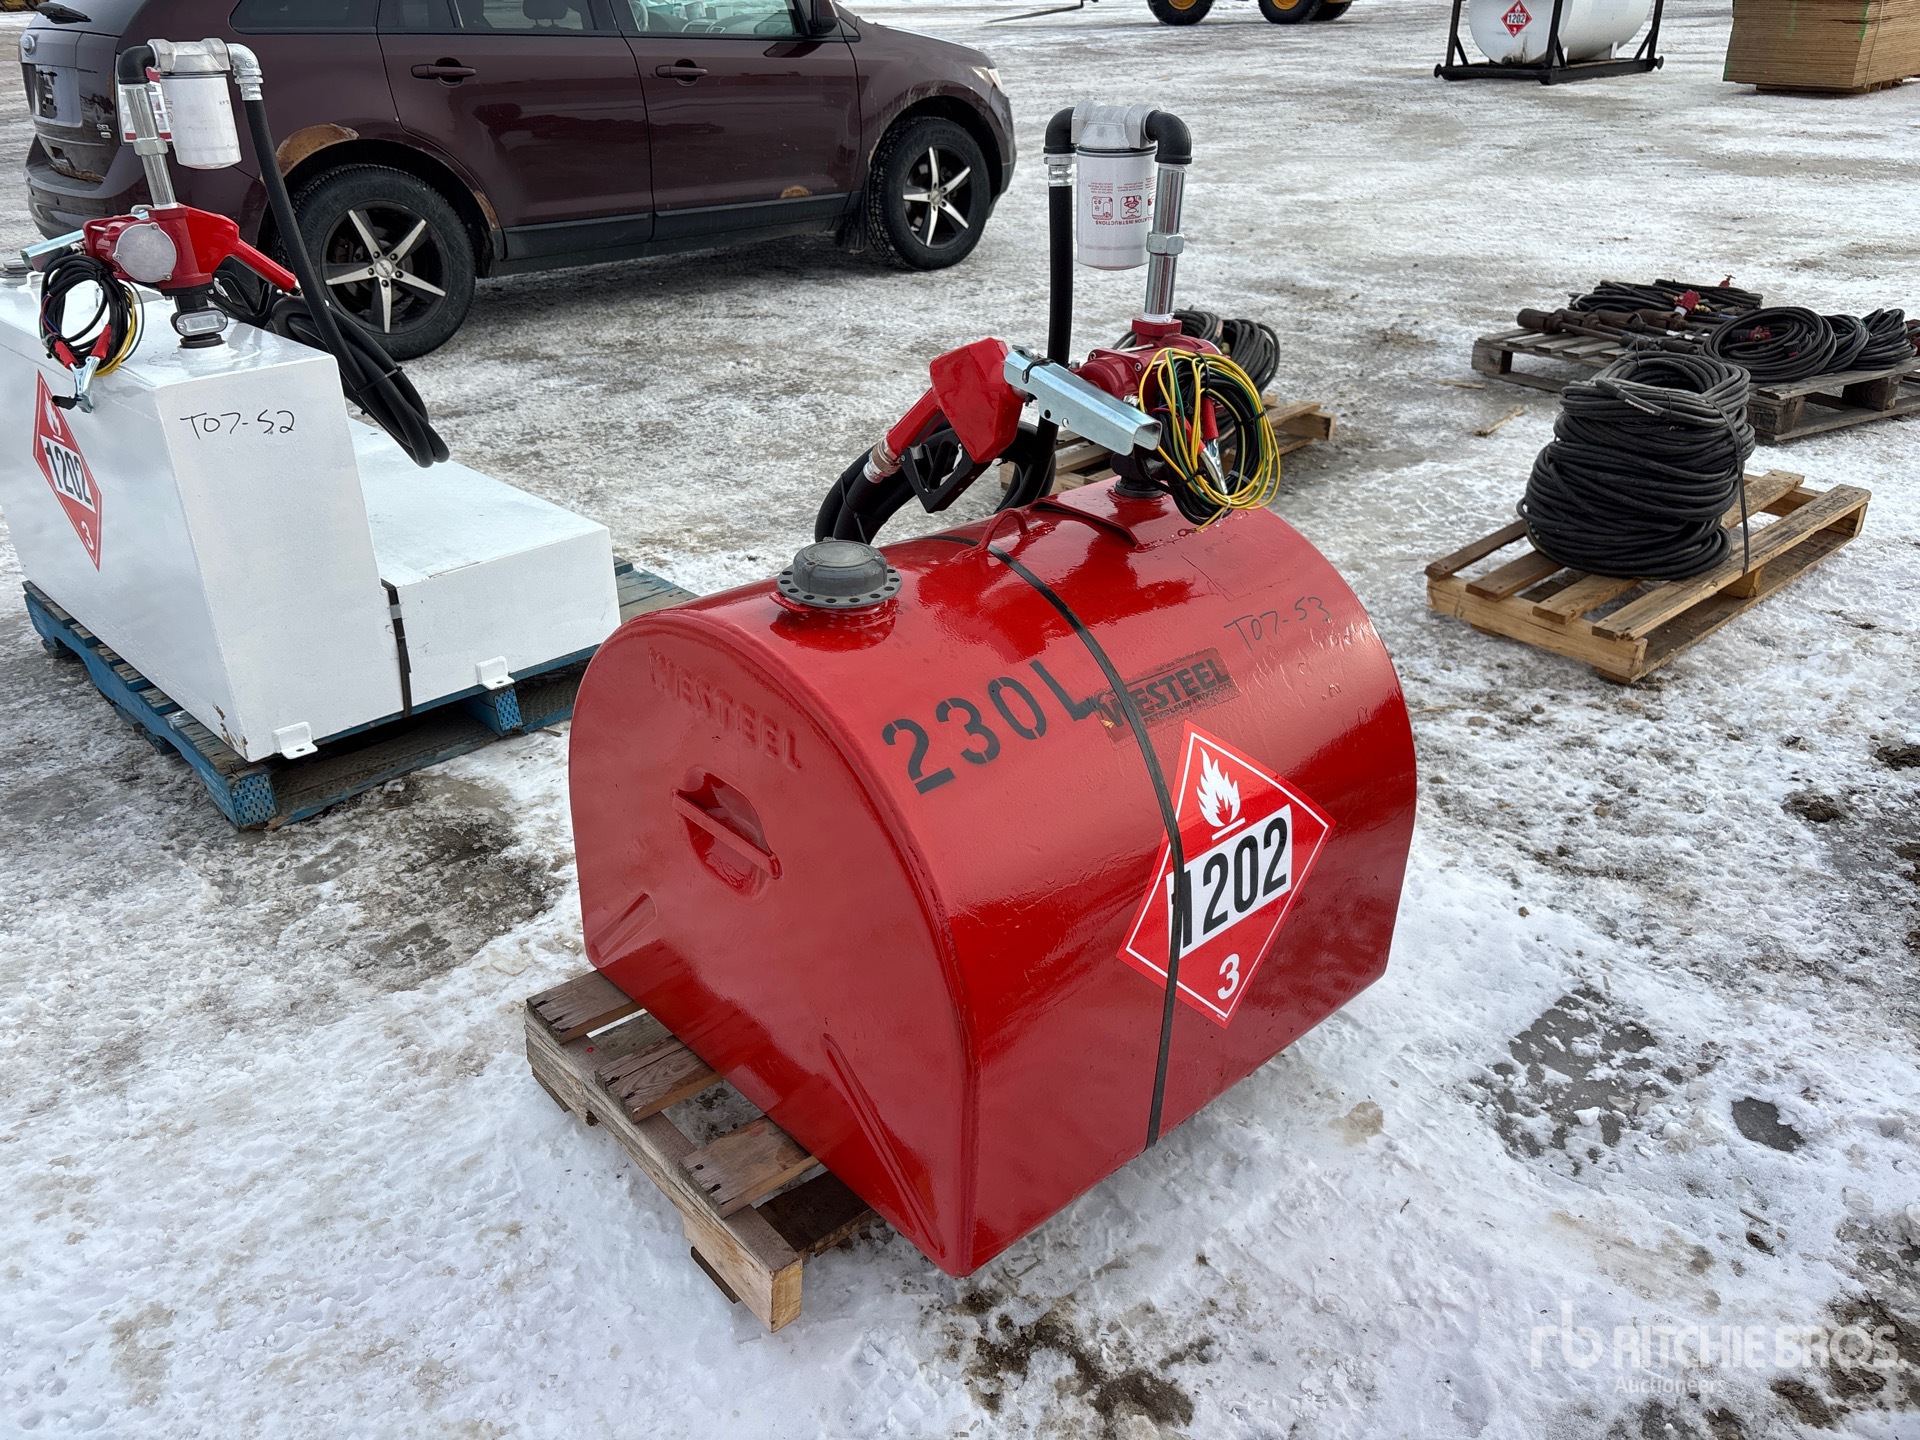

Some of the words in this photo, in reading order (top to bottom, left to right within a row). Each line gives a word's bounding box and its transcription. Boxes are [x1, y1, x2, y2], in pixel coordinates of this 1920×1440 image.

[1508, 14, 1526, 24] 1202
[96, 123, 112, 132] SEL
[45, 441, 93, 507] 1202
[81, 520, 95, 551] 3
[649, 646, 803, 772] WESTEEL
[1100, 658, 1231, 728] WESTEEL
[1143, 699, 1192, 725] PETROLEUM
[1172, 816, 1288, 949] 1202
[1217, 953, 1240, 1000] 3
